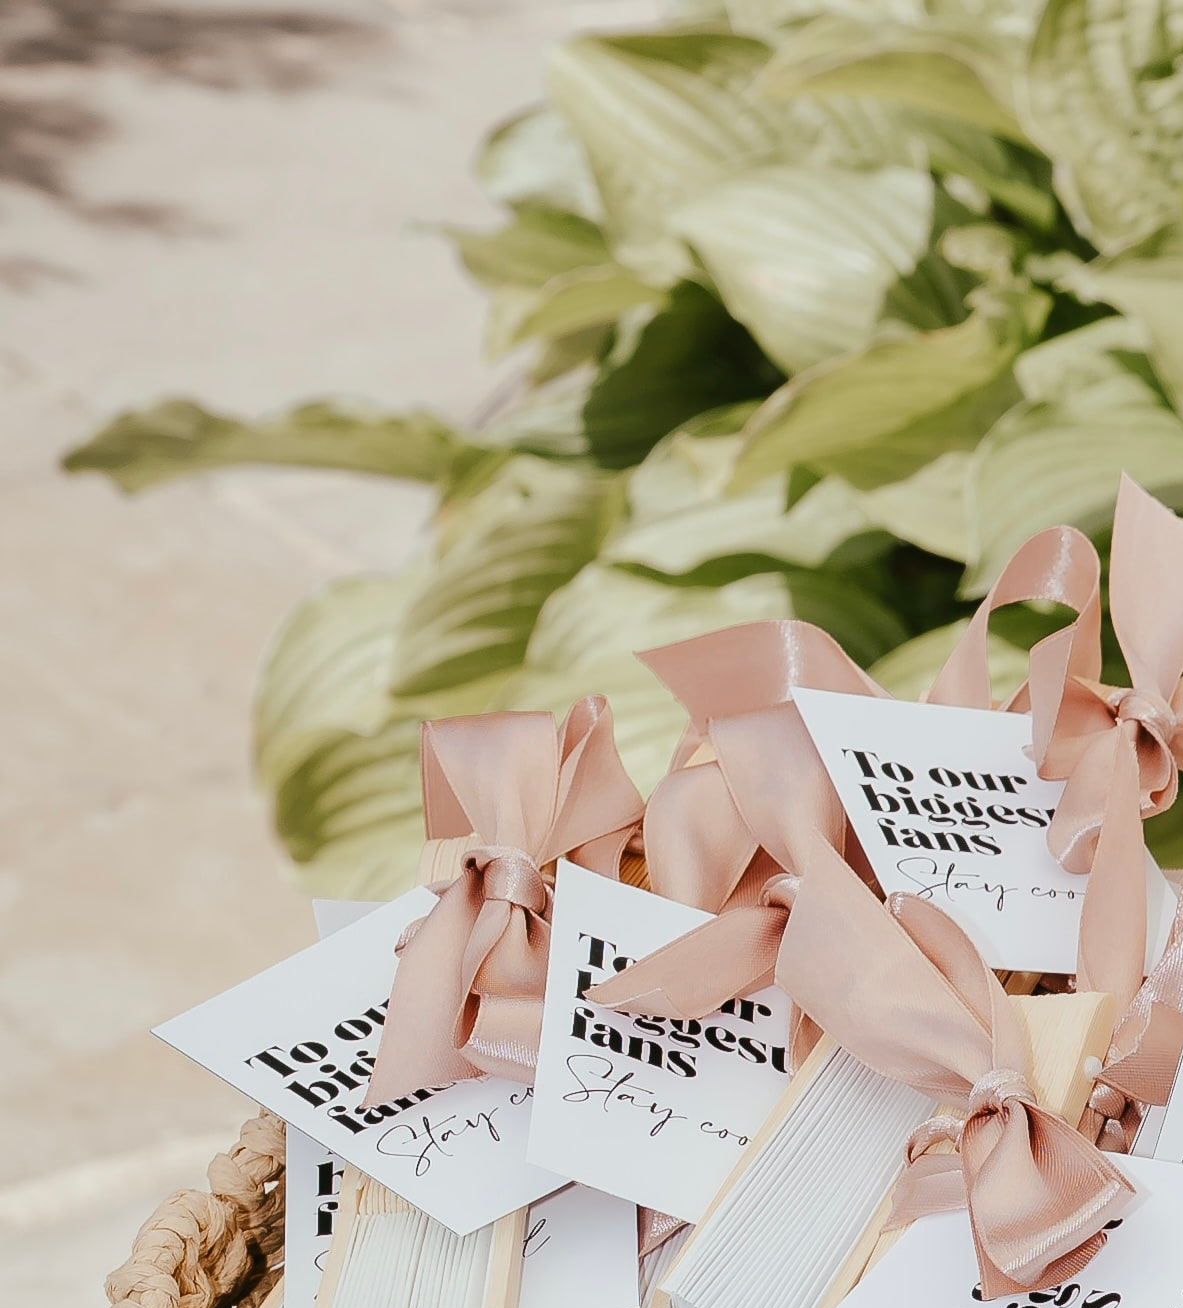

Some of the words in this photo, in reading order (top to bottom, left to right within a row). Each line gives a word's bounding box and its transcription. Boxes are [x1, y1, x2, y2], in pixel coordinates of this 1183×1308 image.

[841, 748, 914, 783] To
[928, 766, 1028, 794] our
[876, 818, 1003, 856] fans
[896, 856, 1018, 912] Stay
[1030, 887, 1087, 901] coo
[244, 1046, 329, 1078] To
[570, 1005, 698, 1078] fans
[562, 1054, 689, 1137] Stay
[700, 1121, 752, 1146] coo
[376, 1107, 499, 1177] Stay
